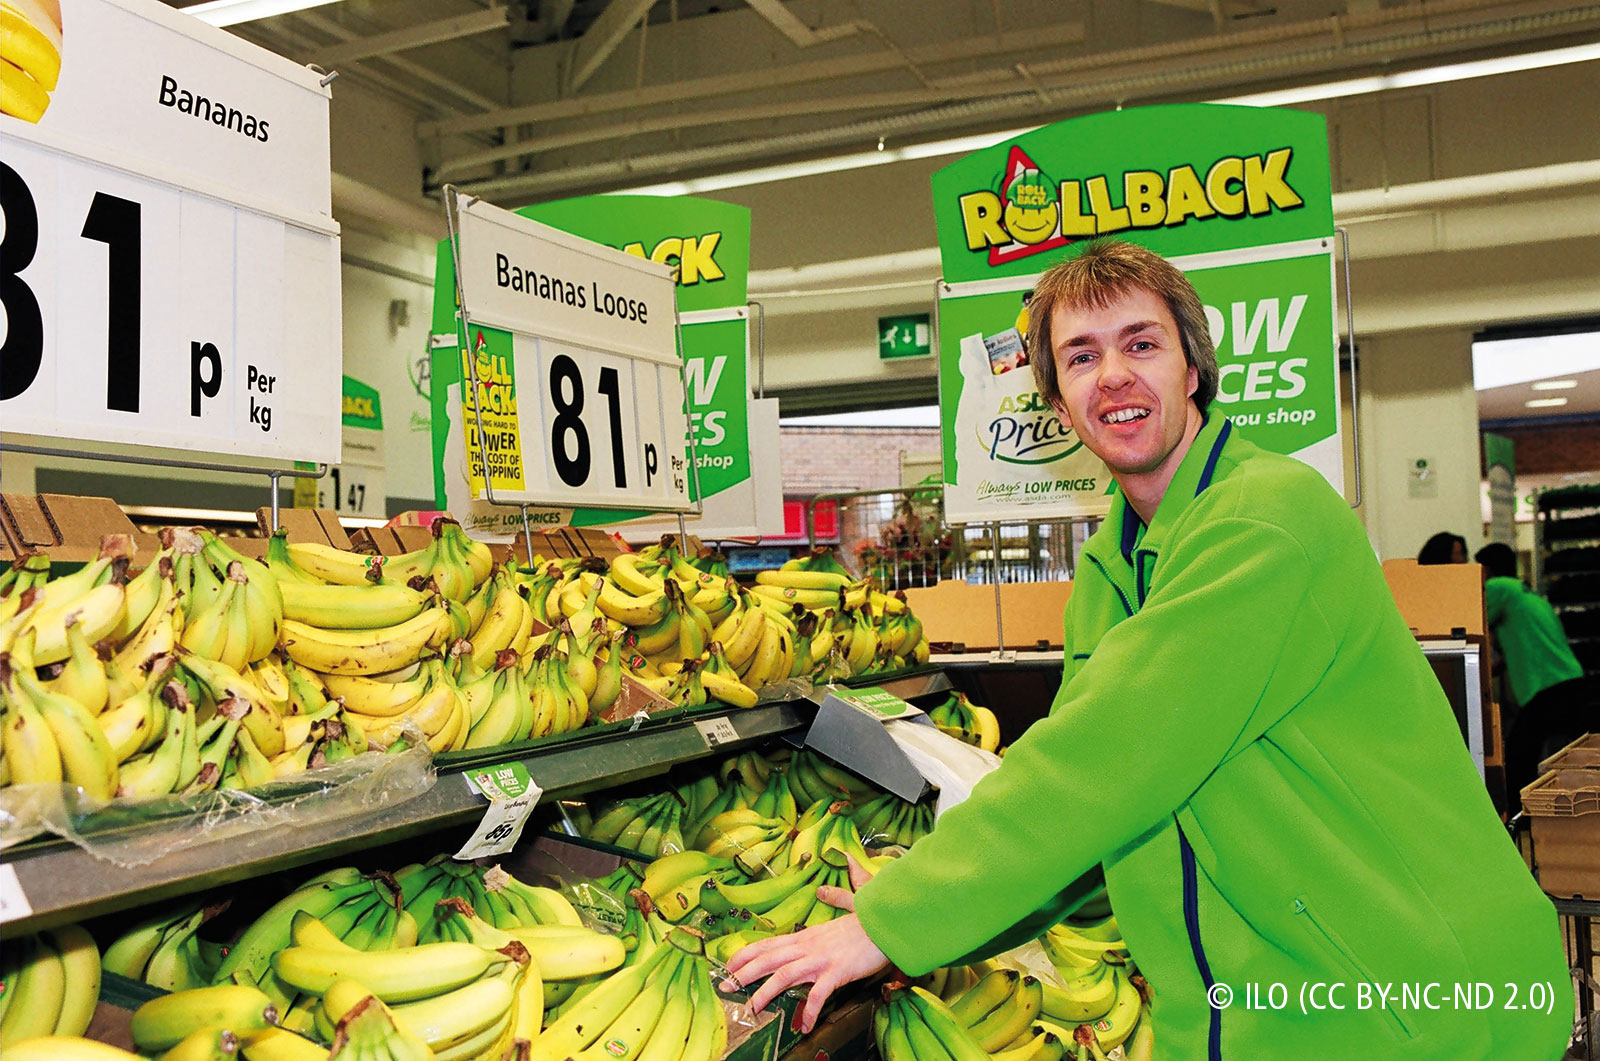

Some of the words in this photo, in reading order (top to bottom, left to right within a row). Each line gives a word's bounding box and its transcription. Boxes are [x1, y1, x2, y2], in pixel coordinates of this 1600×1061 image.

[158, 75, 269, 143] Bananas
[959, 148, 1304, 252] ROLLBACK
[496, 252, 587, 309] Bananas
[593, 281, 648, 325] Loose
[191, 340, 222, 417] p
[247, 364, 276, 395] Per
[249, 396, 272, 432] kg
[549, 354, 628, 489] 81
[644, 443, 658, 487] p
[1266, 407, 1316, 426] shop
[471, 429, 517, 452] LOWER
[472, 464, 521, 480] SHOPPING
[487, 452, 508, 465] COST
[509, 455, 520, 466] OF
[671, 455, 683, 471] Per
[673, 473, 684, 494] kg
[1024, 481, 1053, 494] LOW
[1054, 478, 1097, 492] PRICES
